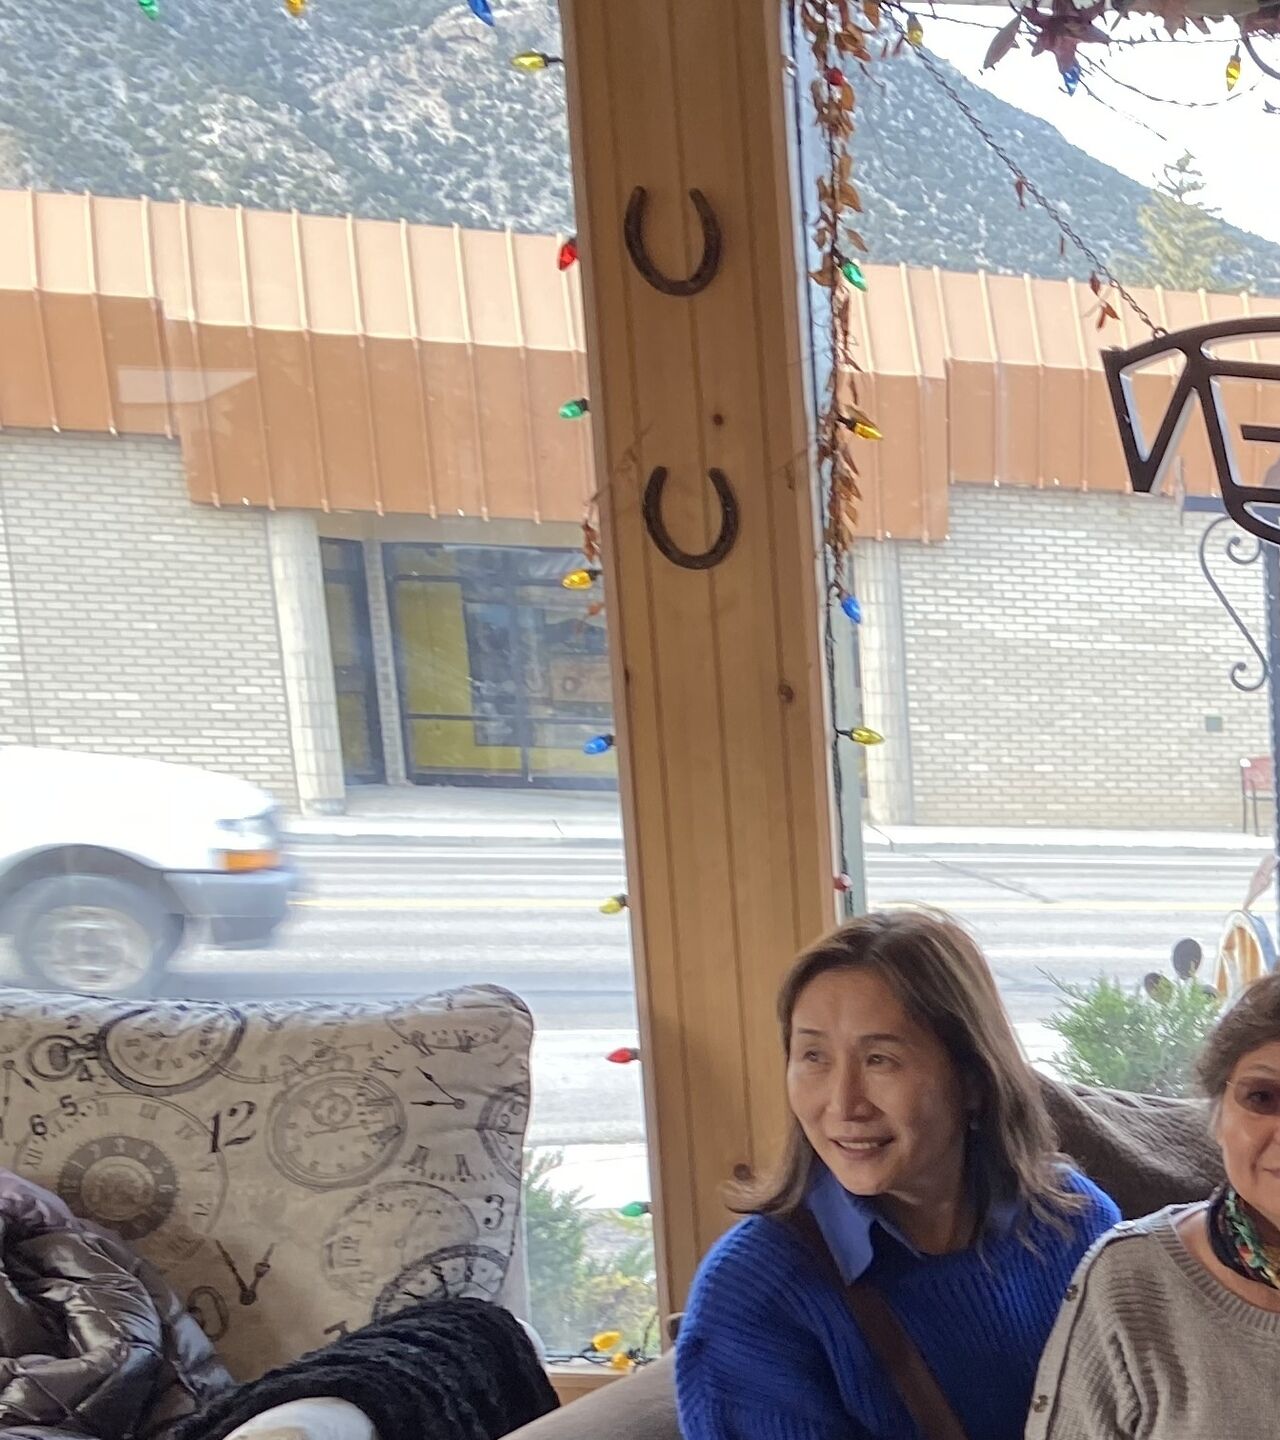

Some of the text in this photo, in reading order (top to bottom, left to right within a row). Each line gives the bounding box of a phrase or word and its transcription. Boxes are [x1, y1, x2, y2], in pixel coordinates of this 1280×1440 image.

[29, 1114, 49, 1136] 6
[210, 1100, 257, 1153] 12
[483, 1193, 505, 1230] 3
